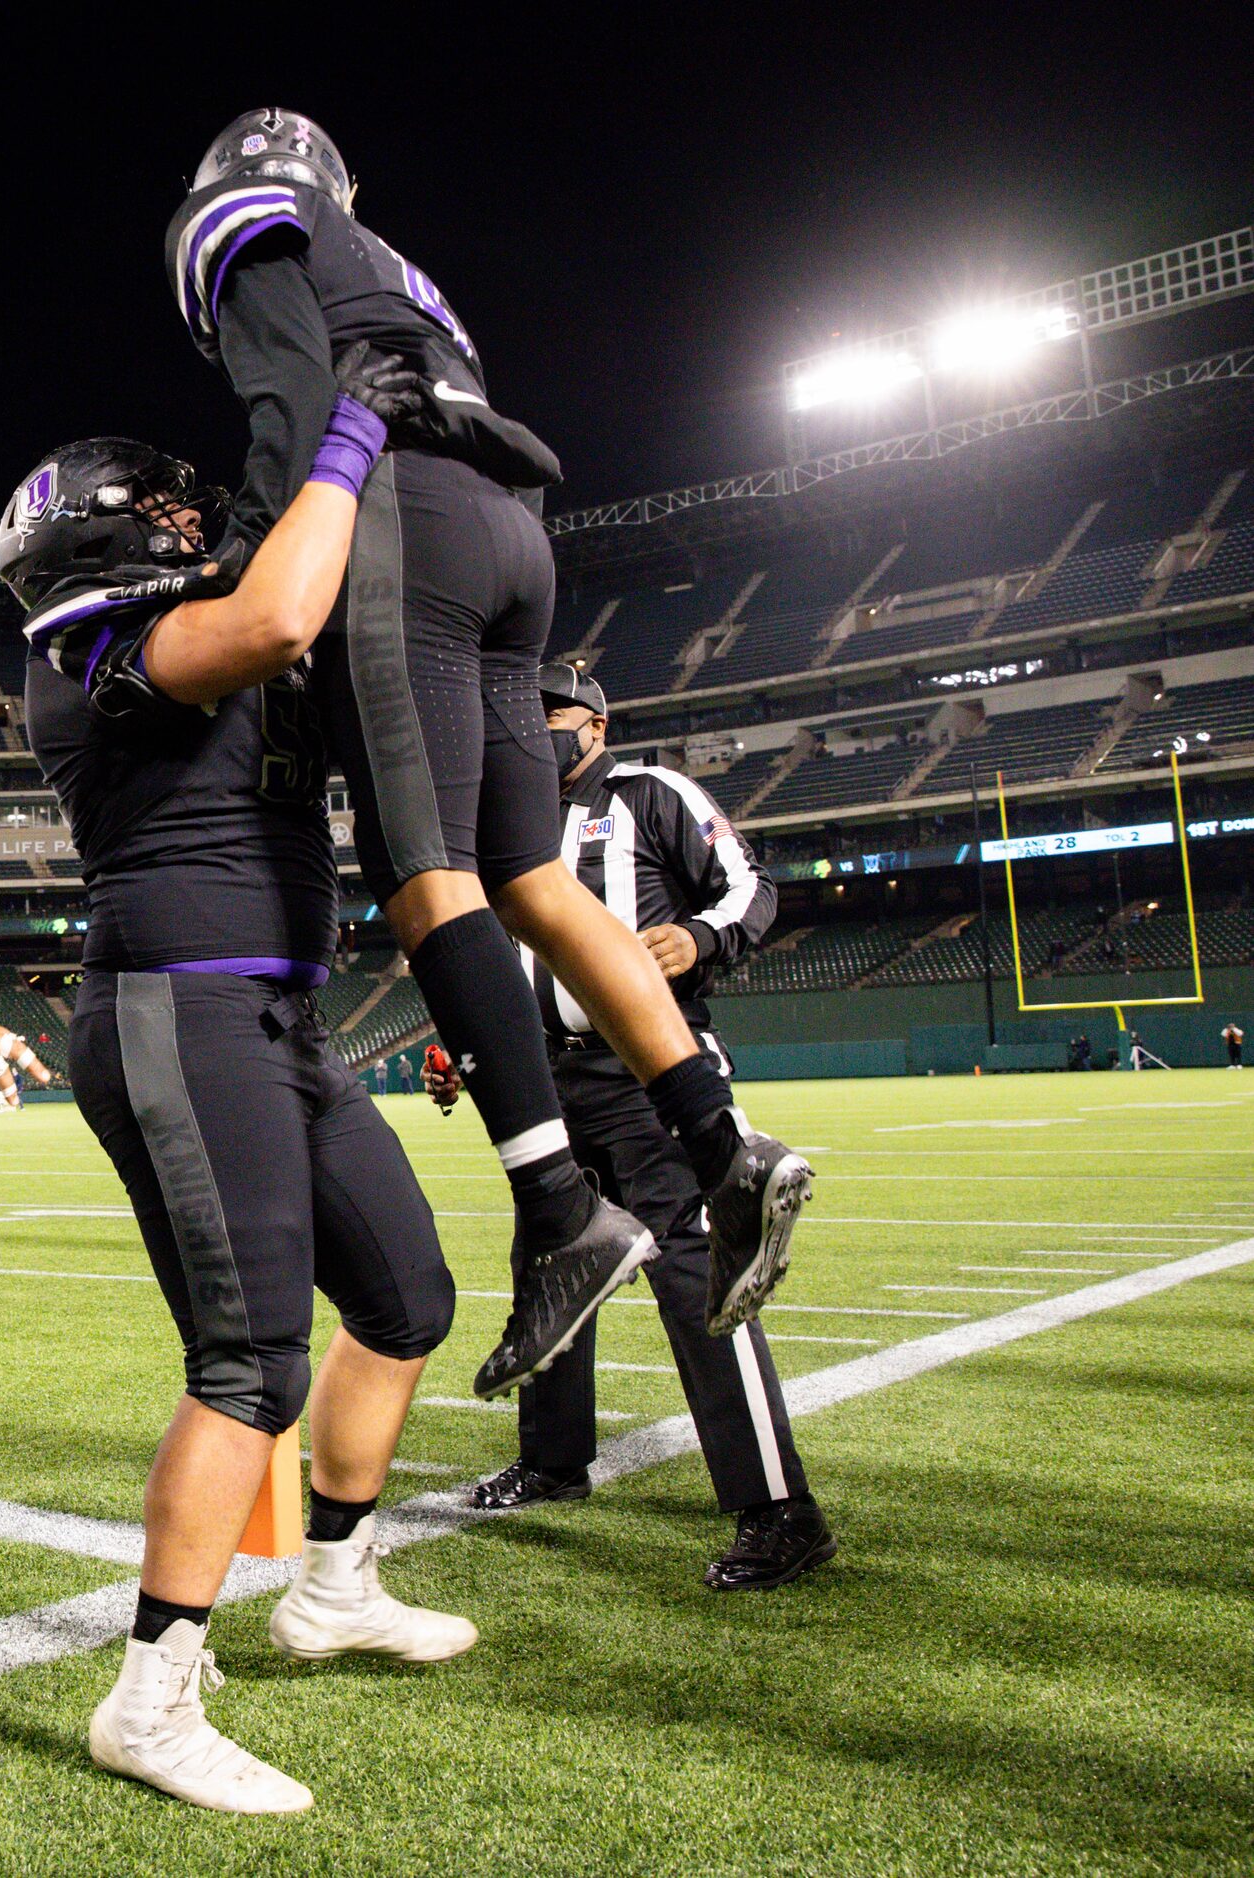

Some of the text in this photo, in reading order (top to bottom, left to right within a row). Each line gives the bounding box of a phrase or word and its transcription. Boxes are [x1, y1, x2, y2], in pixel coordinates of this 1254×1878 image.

[120, 576, 185, 598] VAPOR
[1054, 836, 1077, 849] 28
[1105, 831, 1140, 843] TOL 2
[3, 841, 45, 854] LIFE
